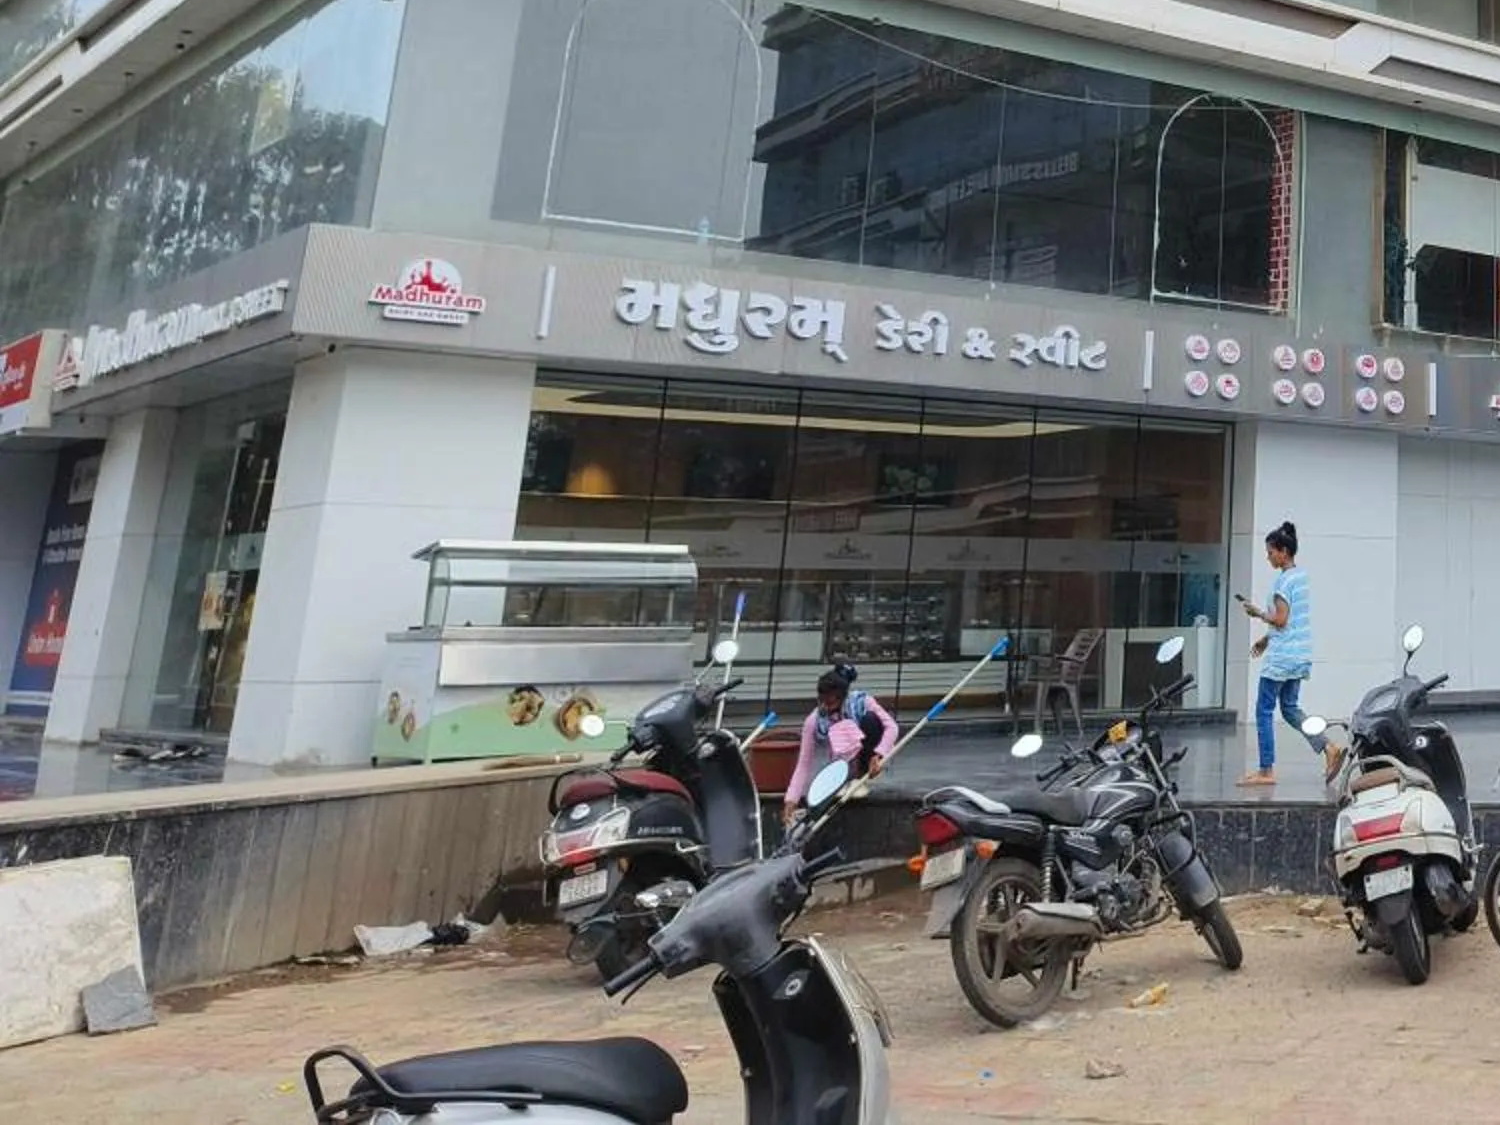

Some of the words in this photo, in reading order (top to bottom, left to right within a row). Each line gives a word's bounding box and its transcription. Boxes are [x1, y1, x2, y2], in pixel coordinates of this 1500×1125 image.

[375, 285, 482, 309] Madhuram
[874, 301, 950, 356] ડેરી
[961, 326, 996, 362] &
